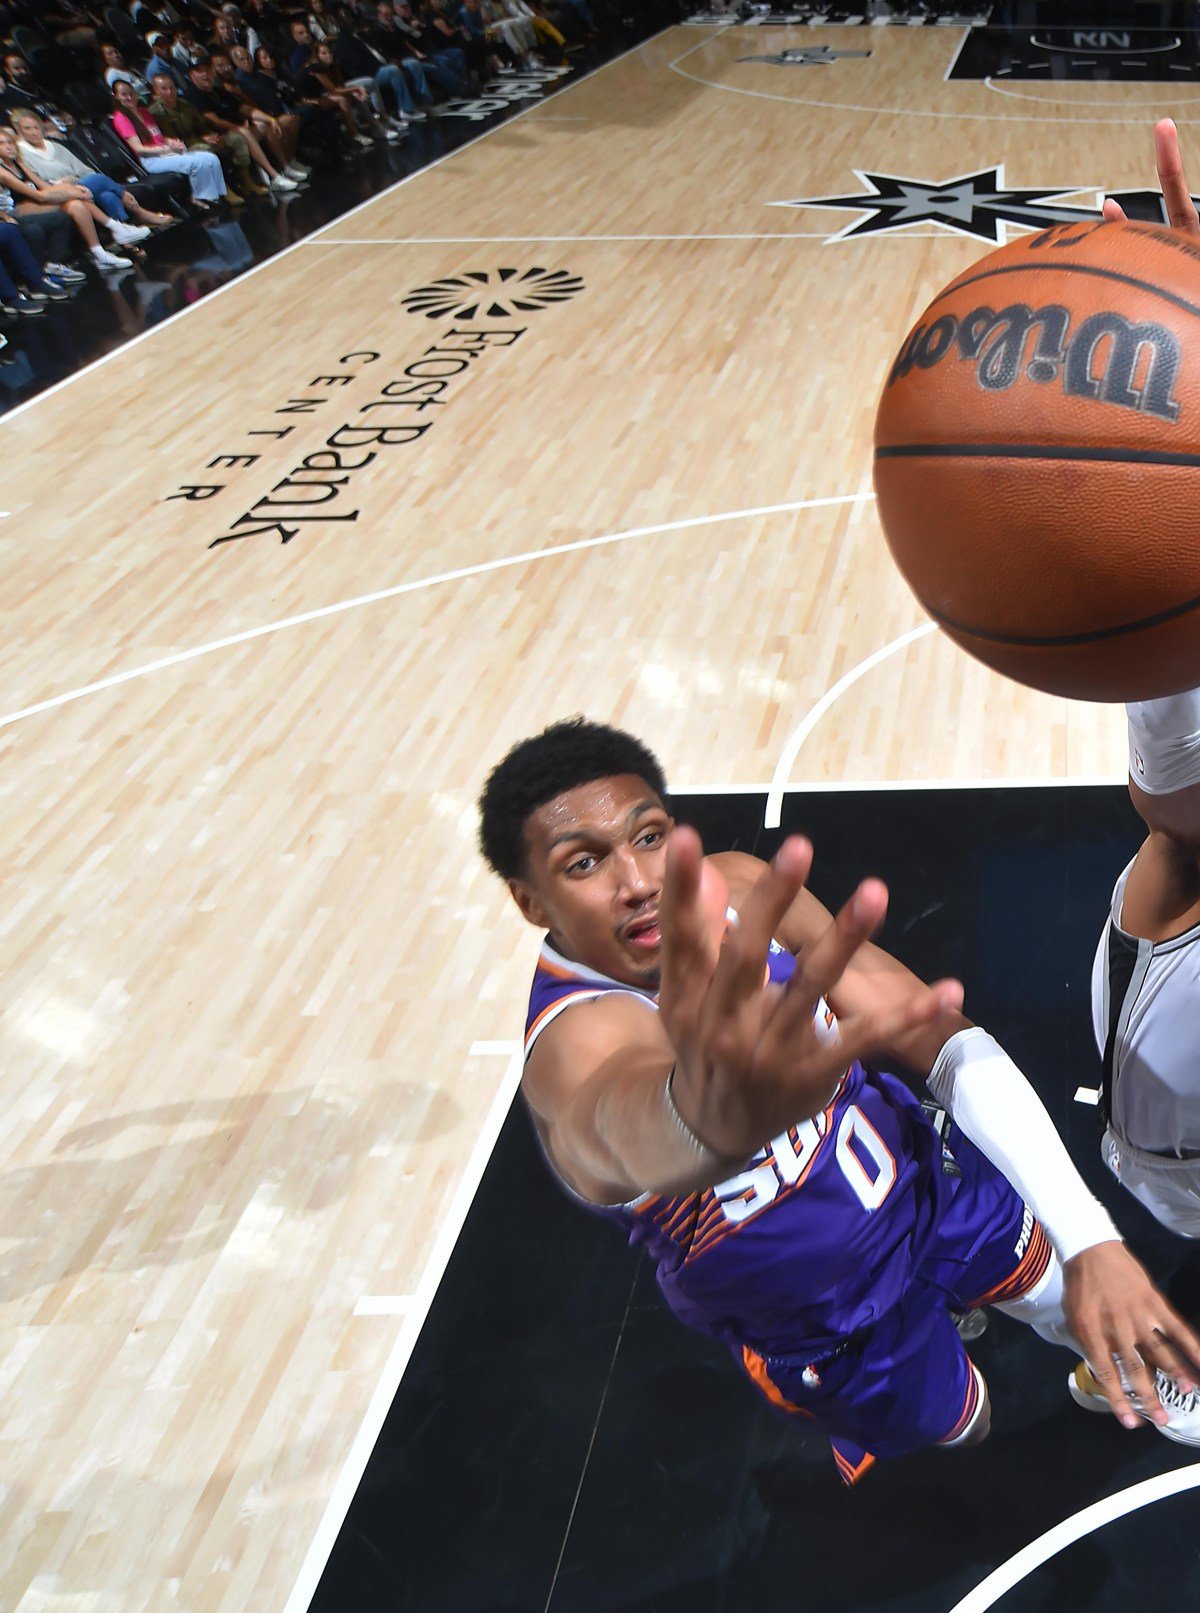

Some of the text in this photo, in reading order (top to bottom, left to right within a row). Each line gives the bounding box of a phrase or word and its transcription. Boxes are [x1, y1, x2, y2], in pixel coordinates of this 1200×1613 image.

[164, 351, 381, 502] CENTER
[207, 327, 529, 549] Frost Bank
[835, 1104, 898, 1213] 0
